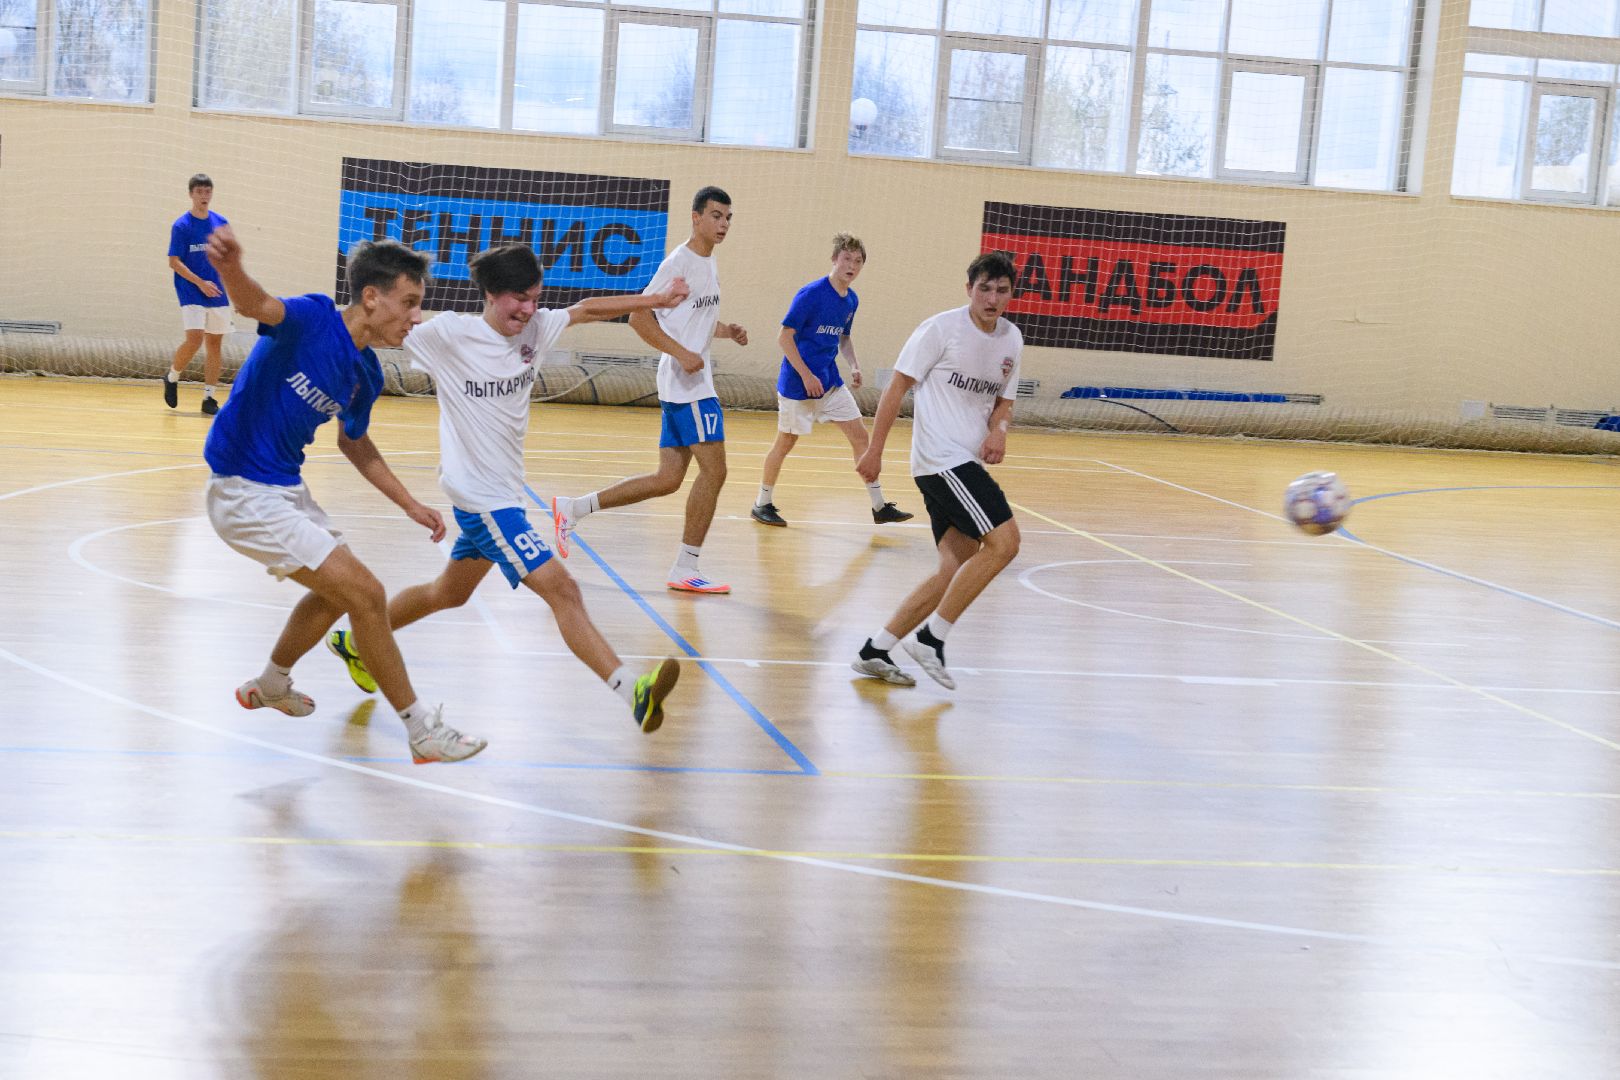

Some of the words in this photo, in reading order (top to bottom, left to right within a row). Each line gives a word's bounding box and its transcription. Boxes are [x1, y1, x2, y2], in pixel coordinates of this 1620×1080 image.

[364, 207, 642, 276] ТЕННИС
[996, 249, 1265, 315] АНДБОЛ
[704, 413, 718, 435] 17
[513, 529, 551, 561] 95
